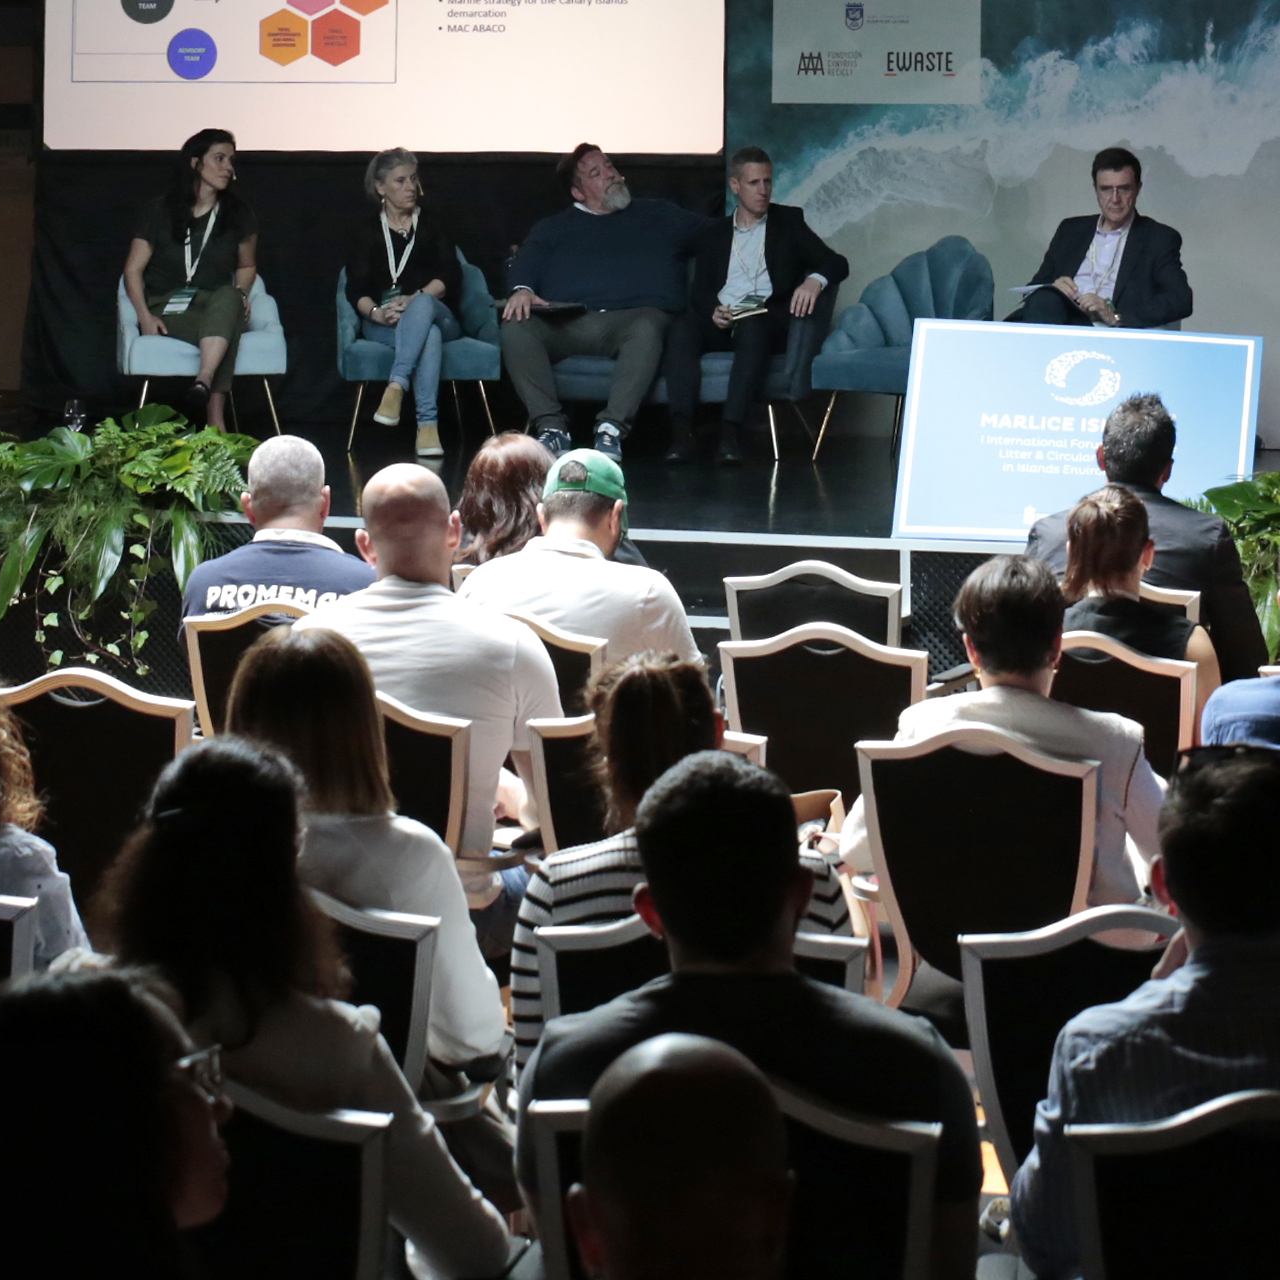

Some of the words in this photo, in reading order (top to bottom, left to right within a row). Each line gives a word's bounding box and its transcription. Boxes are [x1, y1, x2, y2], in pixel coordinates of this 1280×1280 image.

[447, 9, 507, 18] demarcation
[447, 24, 470, 33] MAC
[472, 24, 505, 33] ABACO
[887, 52, 953, 72] EWASTE
[981, 413, 1074, 432] MARLICE
[987, 435, 1067, 448] International
[1070, 438, 1103, 449] Foru
[998, 448, 1032, 460] Litter
[1036, 450, 1043, 460] &
[1047, 450, 1096, 462] Circular
[1002, 462, 1015, 472] in
[1018, 462, 1060, 474] Islands
